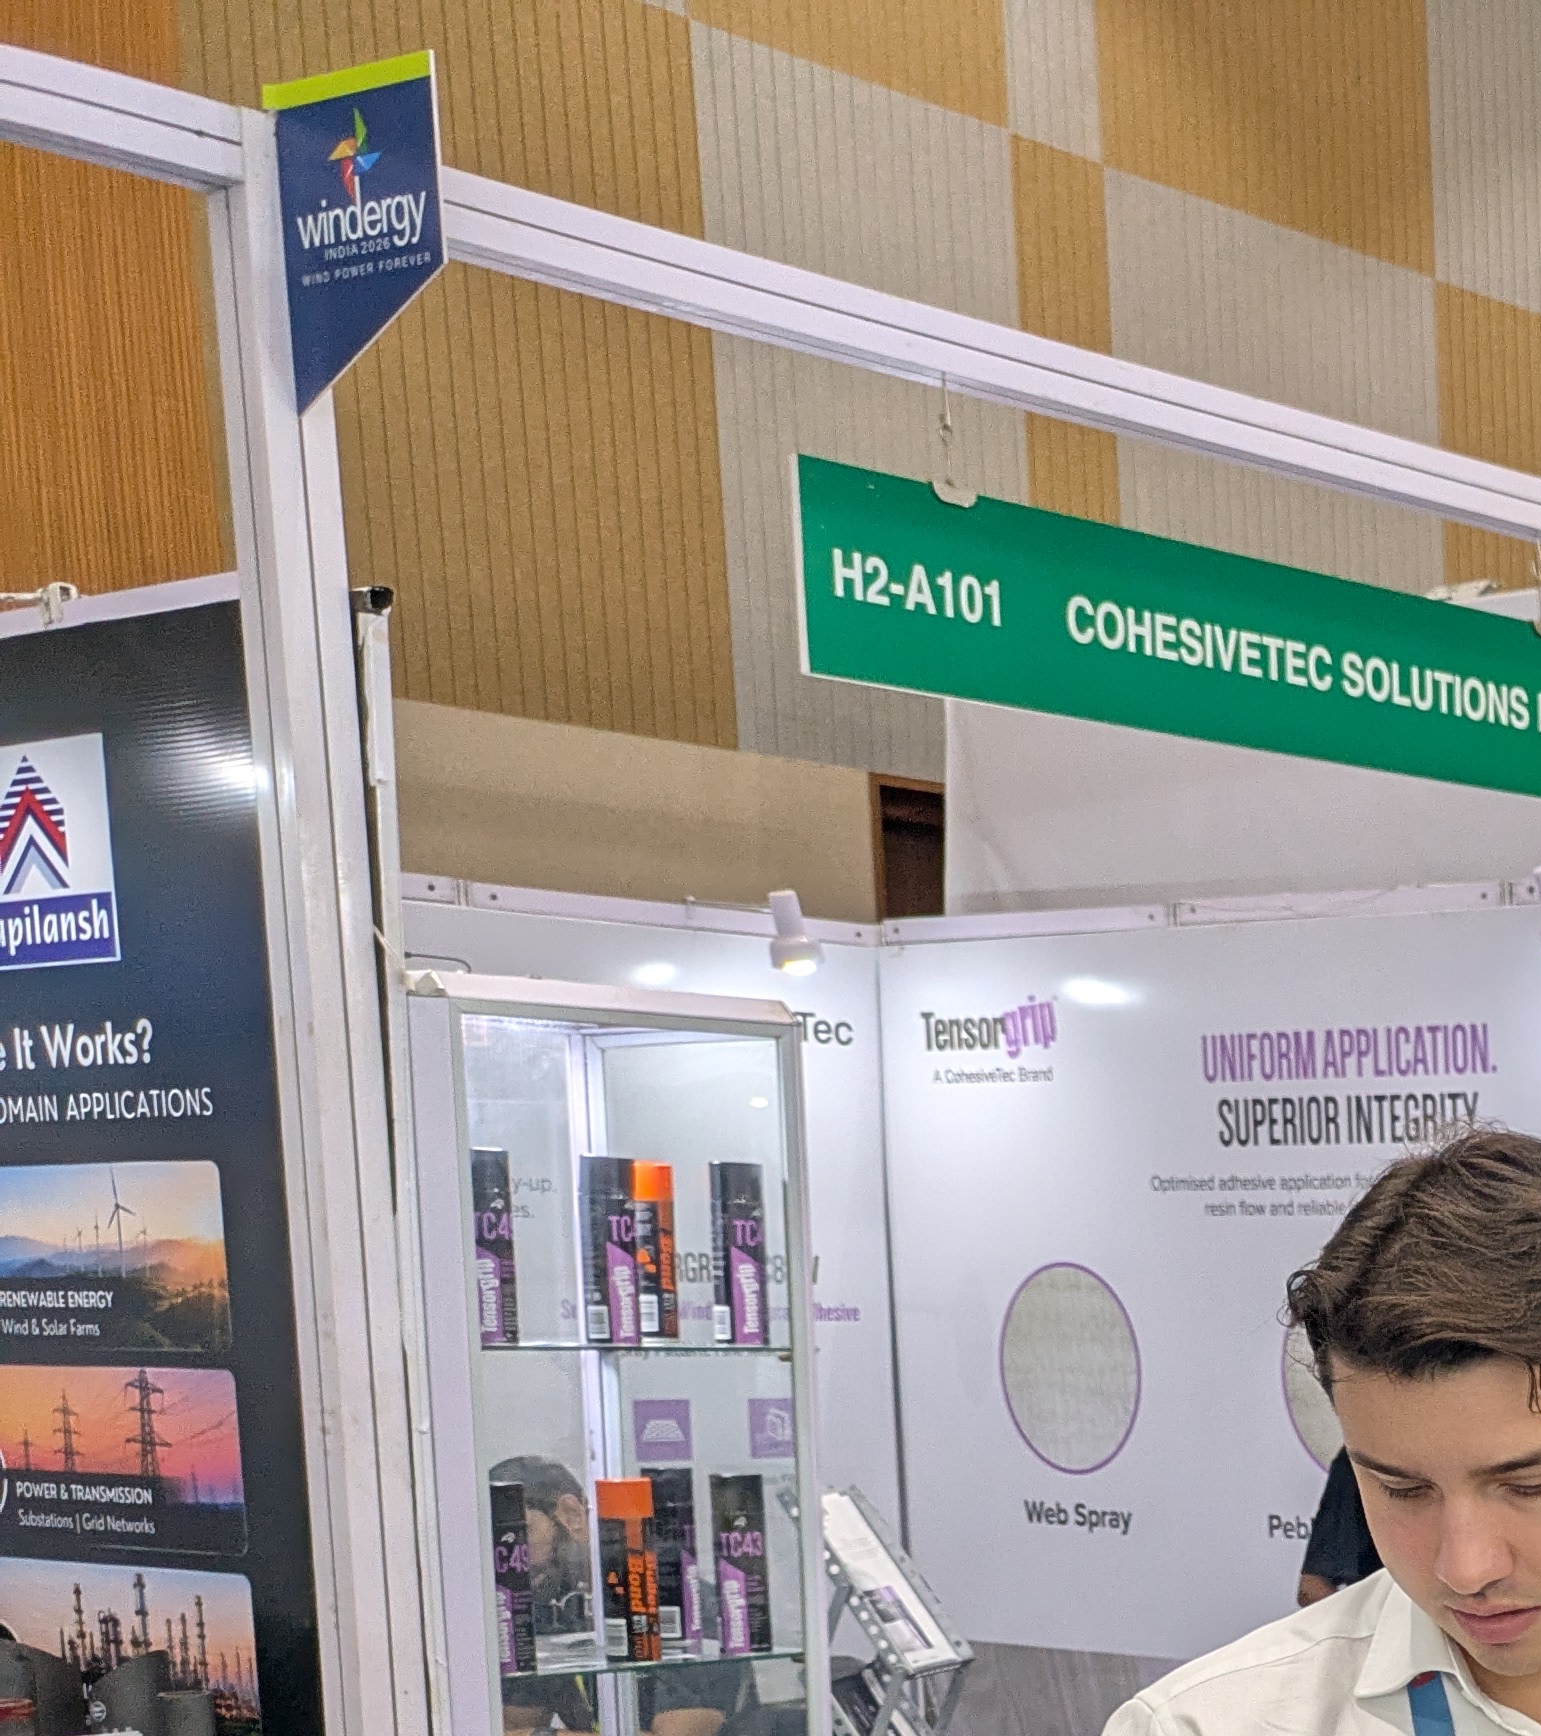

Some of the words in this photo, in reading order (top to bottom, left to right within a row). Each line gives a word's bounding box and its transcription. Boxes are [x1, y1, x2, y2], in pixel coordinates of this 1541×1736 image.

[296, 175, 426, 249] windergy
[324, 243, 358, 260] INDIA
[302, 271, 331, 287] WIND
[334, 261, 374, 280] POWER
[378, 252, 431, 271] FOREVER
[833, 547, 1002, 628] H2-A101
[1066, 594, 1333, 693] COHESIVETEC
[1341, 653, 1530, 731] SOLUTIONS
[920, 993, 1057, 1058] Tensorgrip
[13, 1028, 33, 1071] It
[41, 1018, 153, 1071] Works?
[1201, 1030, 1316, 1084] UNIFORM
[1322, 1022, 1498, 1079] APPLICATION.
[945, 1066, 1016, 1084] CohesiveTec
[1018, 1064, 1053, 1082] Brand
[66, 1087, 213, 1122] APPLICATIONS
[1218, 1093, 1340, 1148] SUPERIOR
[1347, 1091, 1478, 1146] INTEGRITY
[1150, 1175, 1216, 1194] Optimised
[1218, 1175, 1276, 1191] adhesive
[1280, 1175, 1351, 1194] application
[1205, 1202, 1236, 1217] resin
[1239, 1201, 1266, 1217] flow
[1269, 1201, 1294, 1217] and
[67, 1290, 114, 1309] ENERGY
[1, 1317, 29, 1336] Wind
[31, 1318, 40, 1335] &
[42, 1319, 67, 1337] Solar
[70, 1320, 101, 1337] Farms
[15, 1480, 57, 1501] POWER
[59, 1482, 69, 1501] &
[71, 1483, 153, 1506] TRANSMISSION
[18, 1508, 74, 1530] Substations
[82, 1513, 106, 1532] Grid
[107, 1514, 156, 1535] Networks
[1023, 1498, 1069, 1528] Web
[1074, 1503, 1132, 1537] Spray
[1268, 1512, 1317, 1543] Peb
